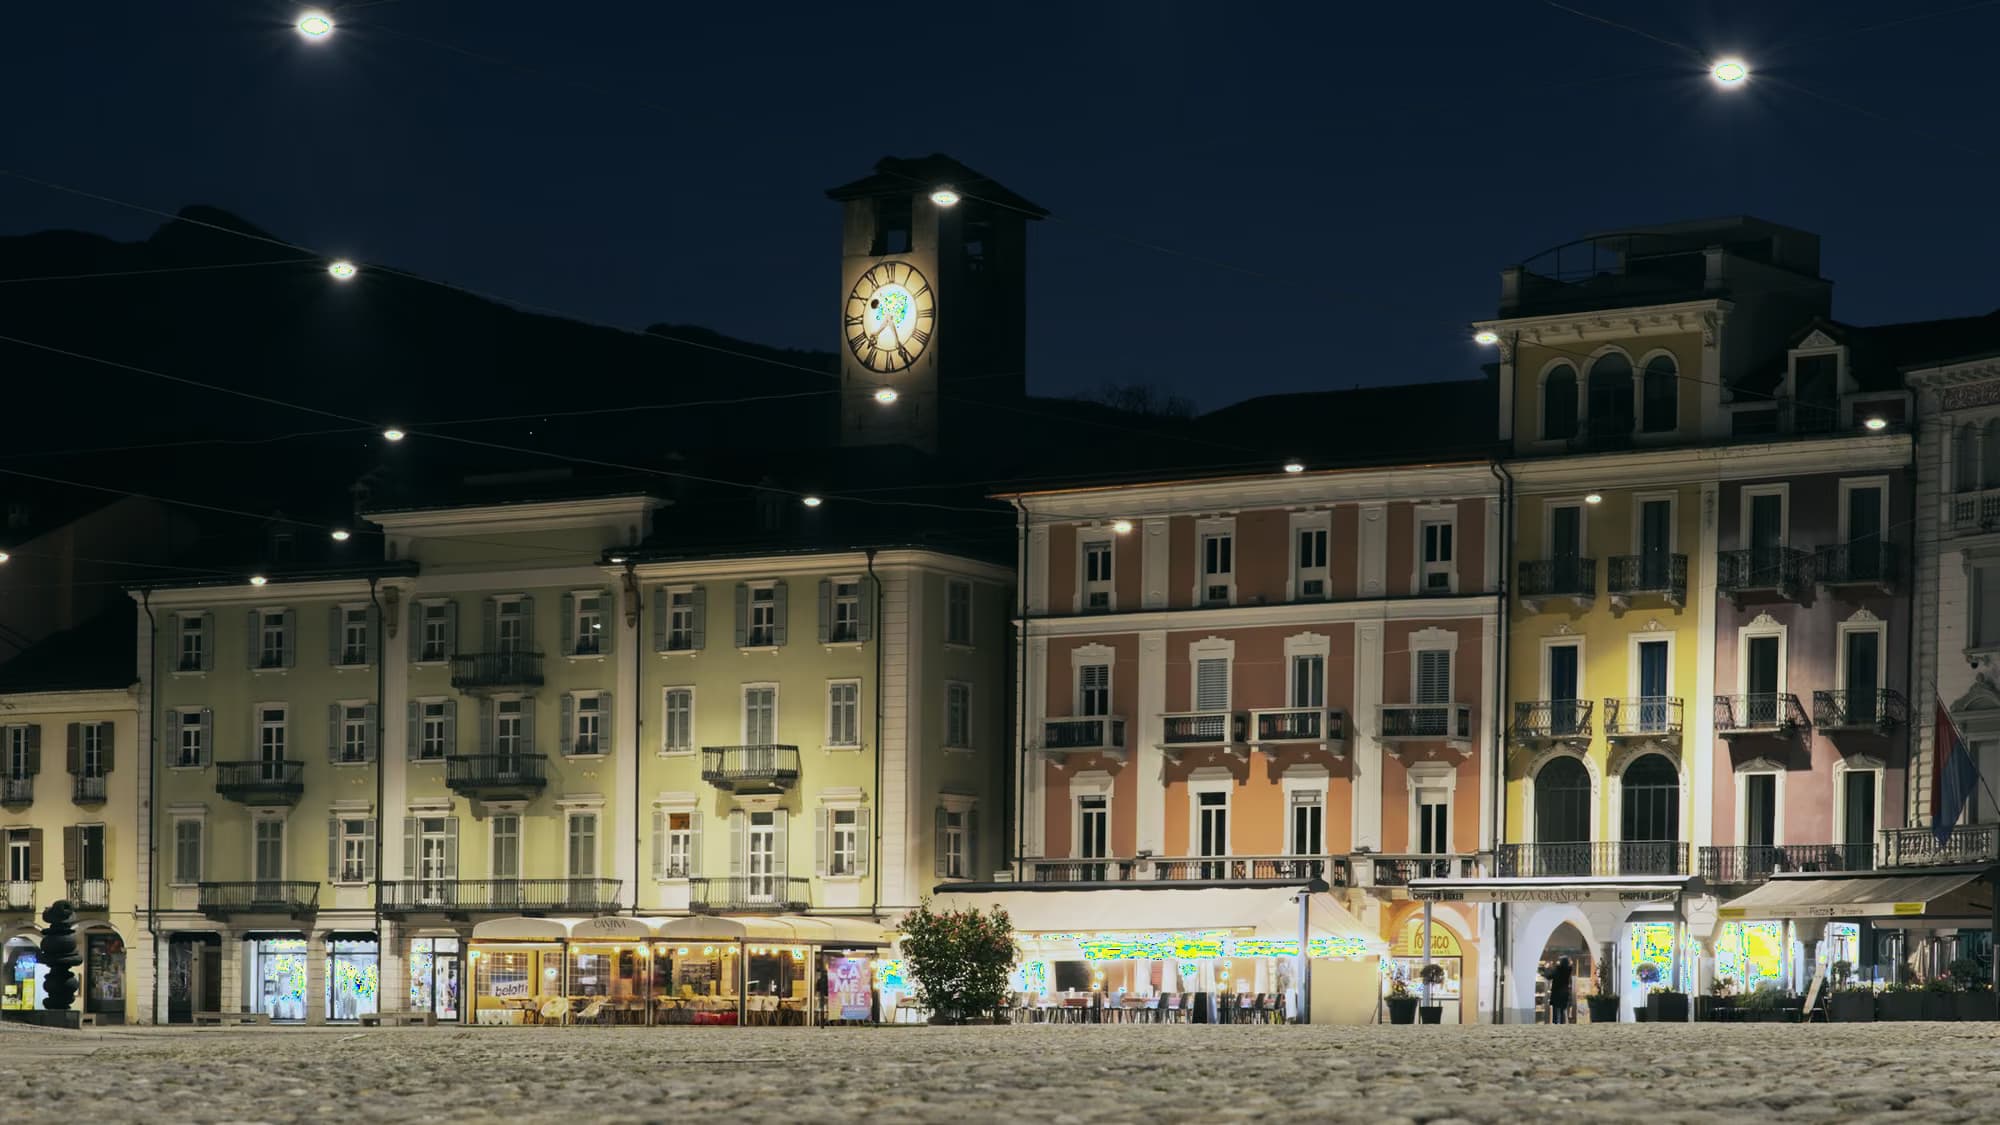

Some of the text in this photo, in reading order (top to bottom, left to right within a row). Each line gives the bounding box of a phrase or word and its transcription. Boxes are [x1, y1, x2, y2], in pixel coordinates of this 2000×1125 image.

[1500, 888, 1580, 901] PIAZZA GRANDE
[837, 964, 859, 979] CA
[841, 992, 865, 1006] LIE
